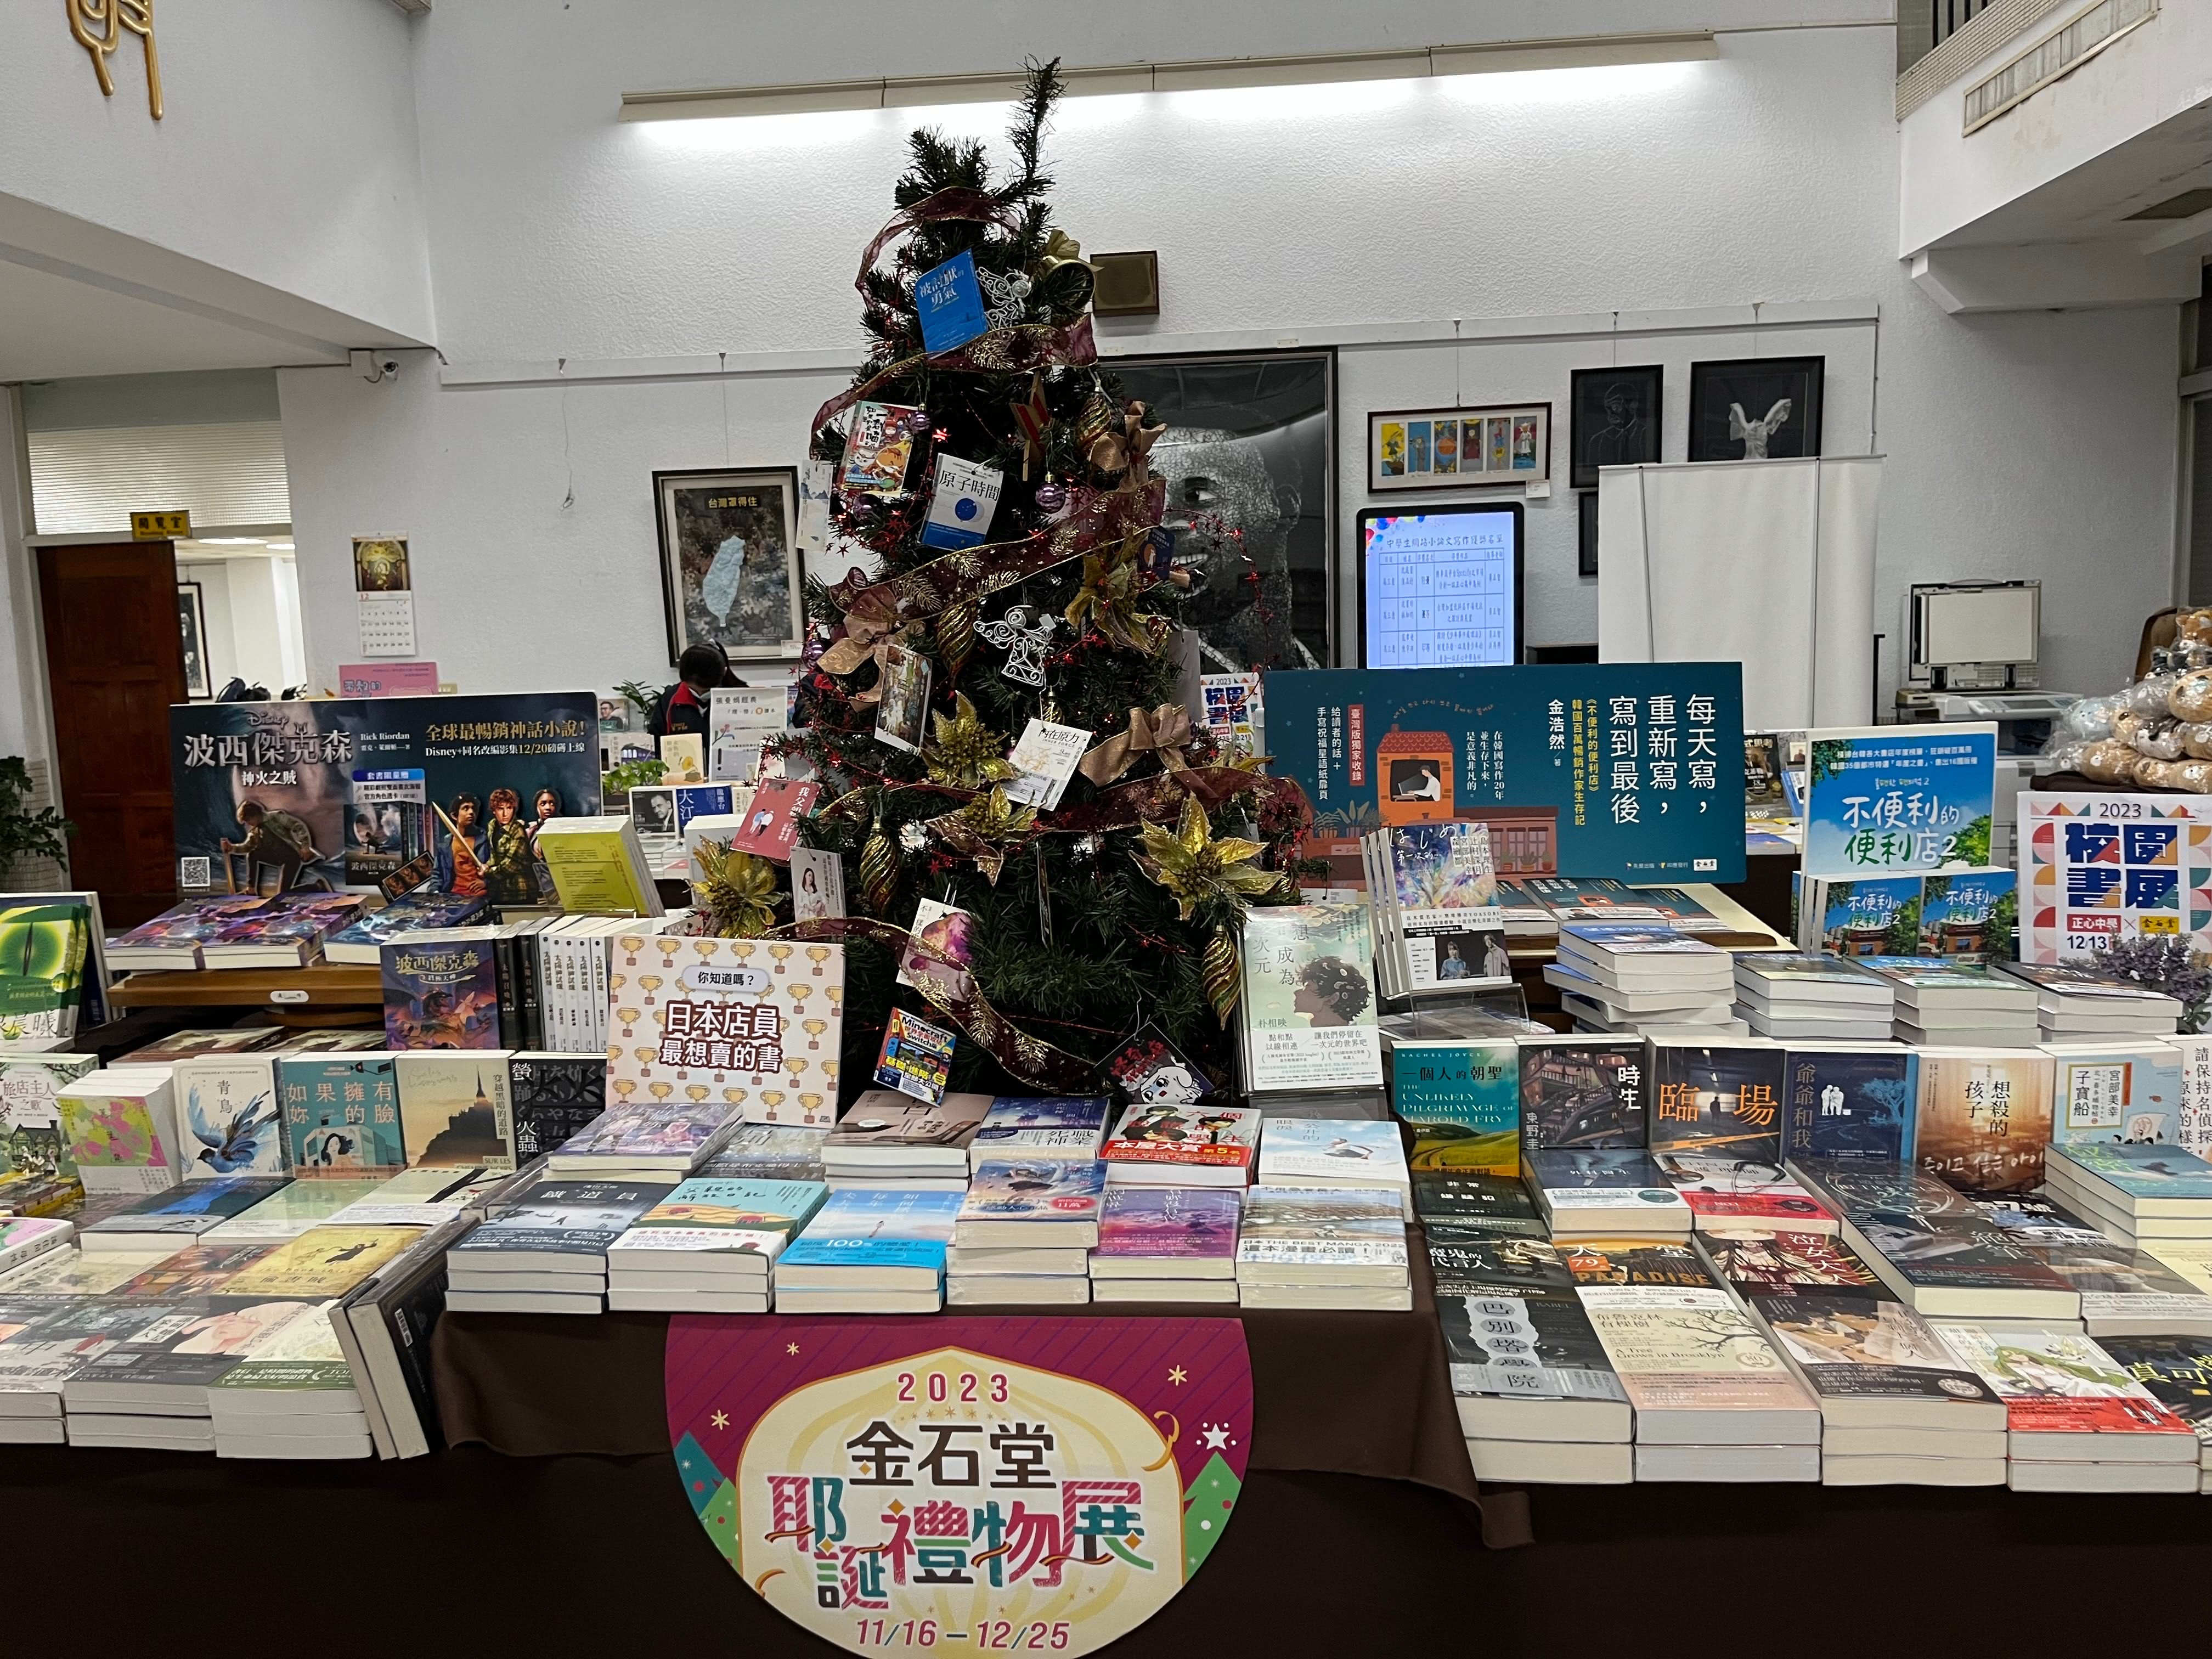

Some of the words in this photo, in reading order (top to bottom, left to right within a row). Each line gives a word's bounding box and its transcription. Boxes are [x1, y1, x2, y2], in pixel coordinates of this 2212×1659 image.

[939, 469, 1001, 501] 原子時間
[708, 496, 758, 509] 台灣罩得住
[184, 724, 353, 768] 波西傑克森
[360, 732, 377, 741] Rick
[379, 731, 410, 741] Riordan
[1038, 729, 1080, 743] 內在原力
[1351, 708, 1362, 781] 臺灣版獨家收錄
[1587, 698, 1599, 792] 《不便利的便利店》
[1317, 707, 1328, 800] 手寫祝福星語紙扉頁
[1493, 731, 1505, 800] 在韓國寫作20年
[1572, 699, 1585, 826] 韓國百萬暢銷作家生存記
[1609, 696, 1640, 823] 寫到最後
[241, 770, 297, 786] 神火之賊
[1842, 792, 1960, 829] 不便利的
[2100, 803, 2141, 818] 2023
[1844, 829, 1957, 866] 便利店2
[1848, 895, 1902, 912] 不便利的
[1945, 889, 1998, 906] 不便利的
[1848, 912, 1900, 928] 便利店2
[1945, 906, 1997, 923] 便利店2
[2072, 917, 2118, 930] 正心中學
[395, 950, 479, 973] 波西傑克森
[1277, 946, 1295, 985] 成為
[667, 1003, 780, 1039] 日本店員
[901, 1017, 948, 1042] Minecraft
[1259, 1018, 1288, 1028] 朴相映
[1268, 1033, 1293, 1041] 點和點
[1311, 1039, 1368, 1048] 一次元的世界吧
[1314, 1030, 1363, 1040] 讓我們停留在
[661, 1040, 783, 1073] 最想賣的書
[512, 1063, 532, 1080] 螢
[1401, 1066, 1503, 1081] 一個人的朝聖
[4, 1080, 55, 1097] 旅店主人
[217, 1079, 233, 1114] 青鳥
[286, 1081, 393, 1102] 如果擁有
[1402, 1093, 1475, 1101] UNLIKELY
[1617, 1065, 1641, 1110] 時生
[1964, 1081, 1984, 1119] 孩子
[2074, 1070, 2091, 1116] 子寶船
[2107, 1070, 2121, 1117] 宮部美幸
[290, 1105, 396, 1125] 妳的臉
[493, 1074, 509, 1136] 穿越黑暗的道路
[1402, 1104, 1499, 1113] PILGRIMAGE
[1658, 1082, 1779, 1126] 臨場
[1792, 1063, 1816, 1149] 爺爺和我
[1989, 1081, 2011, 1137] 想殺的
[1403, 1115, 1469, 1124] HAROLD
[1474, 1115, 1502, 1124] FRY
[516, 1121, 539, 1152] 火蟲
[1113, 1142, 1201, 1152] 本屋大賞
[2011, 1151, 2043, 1168] 아이
[686, 1186, 743, 1194] 父親的
[1575, 1272, 1713, 1285] PARADISE
[898, 1373, 1009, 1402] 2023
[847, 1421, 1057, 1489] 金石堂
[765, 1475, 1155, 1611] 耶誕禮物展
[857, 1620, 937, 1647] 11/16
[976, 1620, 1070, 1649] 12/25
